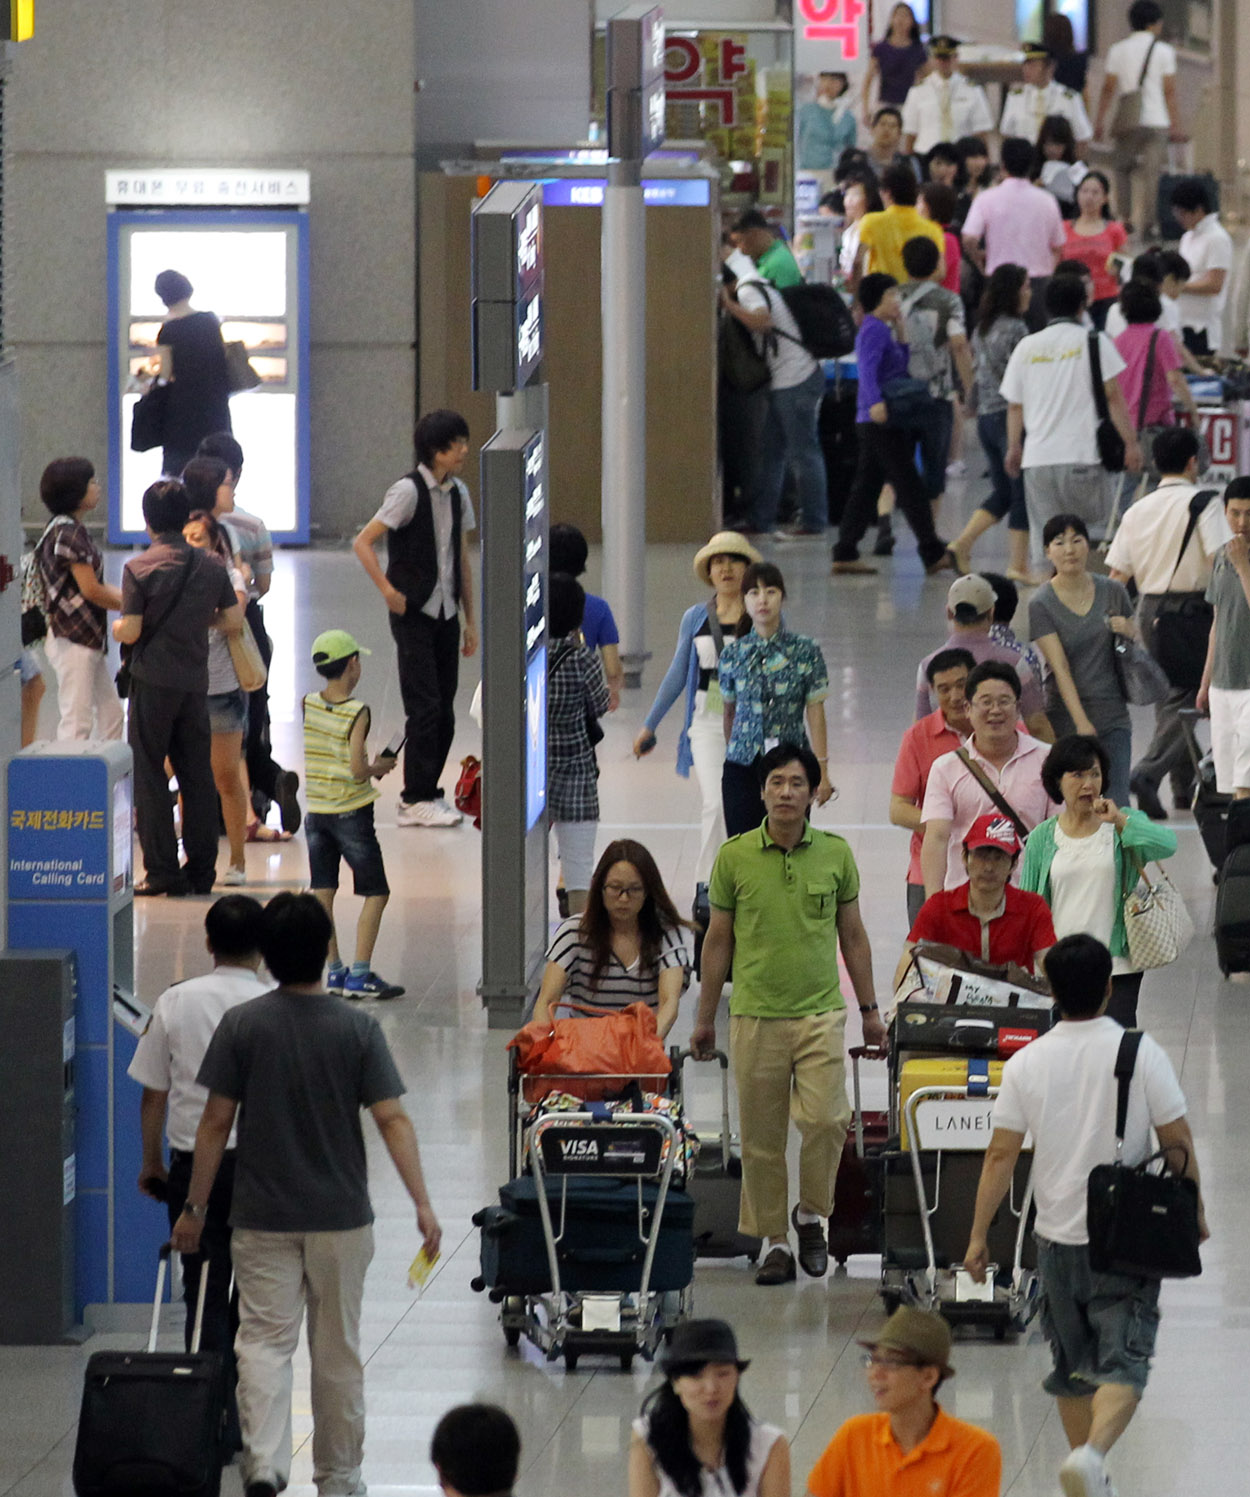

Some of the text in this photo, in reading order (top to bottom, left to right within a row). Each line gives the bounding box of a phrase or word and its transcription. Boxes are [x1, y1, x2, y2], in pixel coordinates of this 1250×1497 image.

[799, 0, 866, 59] 약
[664, 37, 747, 125] 약
[10, 810, 105, 830] 국제전화카드
[10, 859, 83, 872] International
[32, 871, 105, 887] Calling Card
[560, 1140, 599, 1155] VISA
